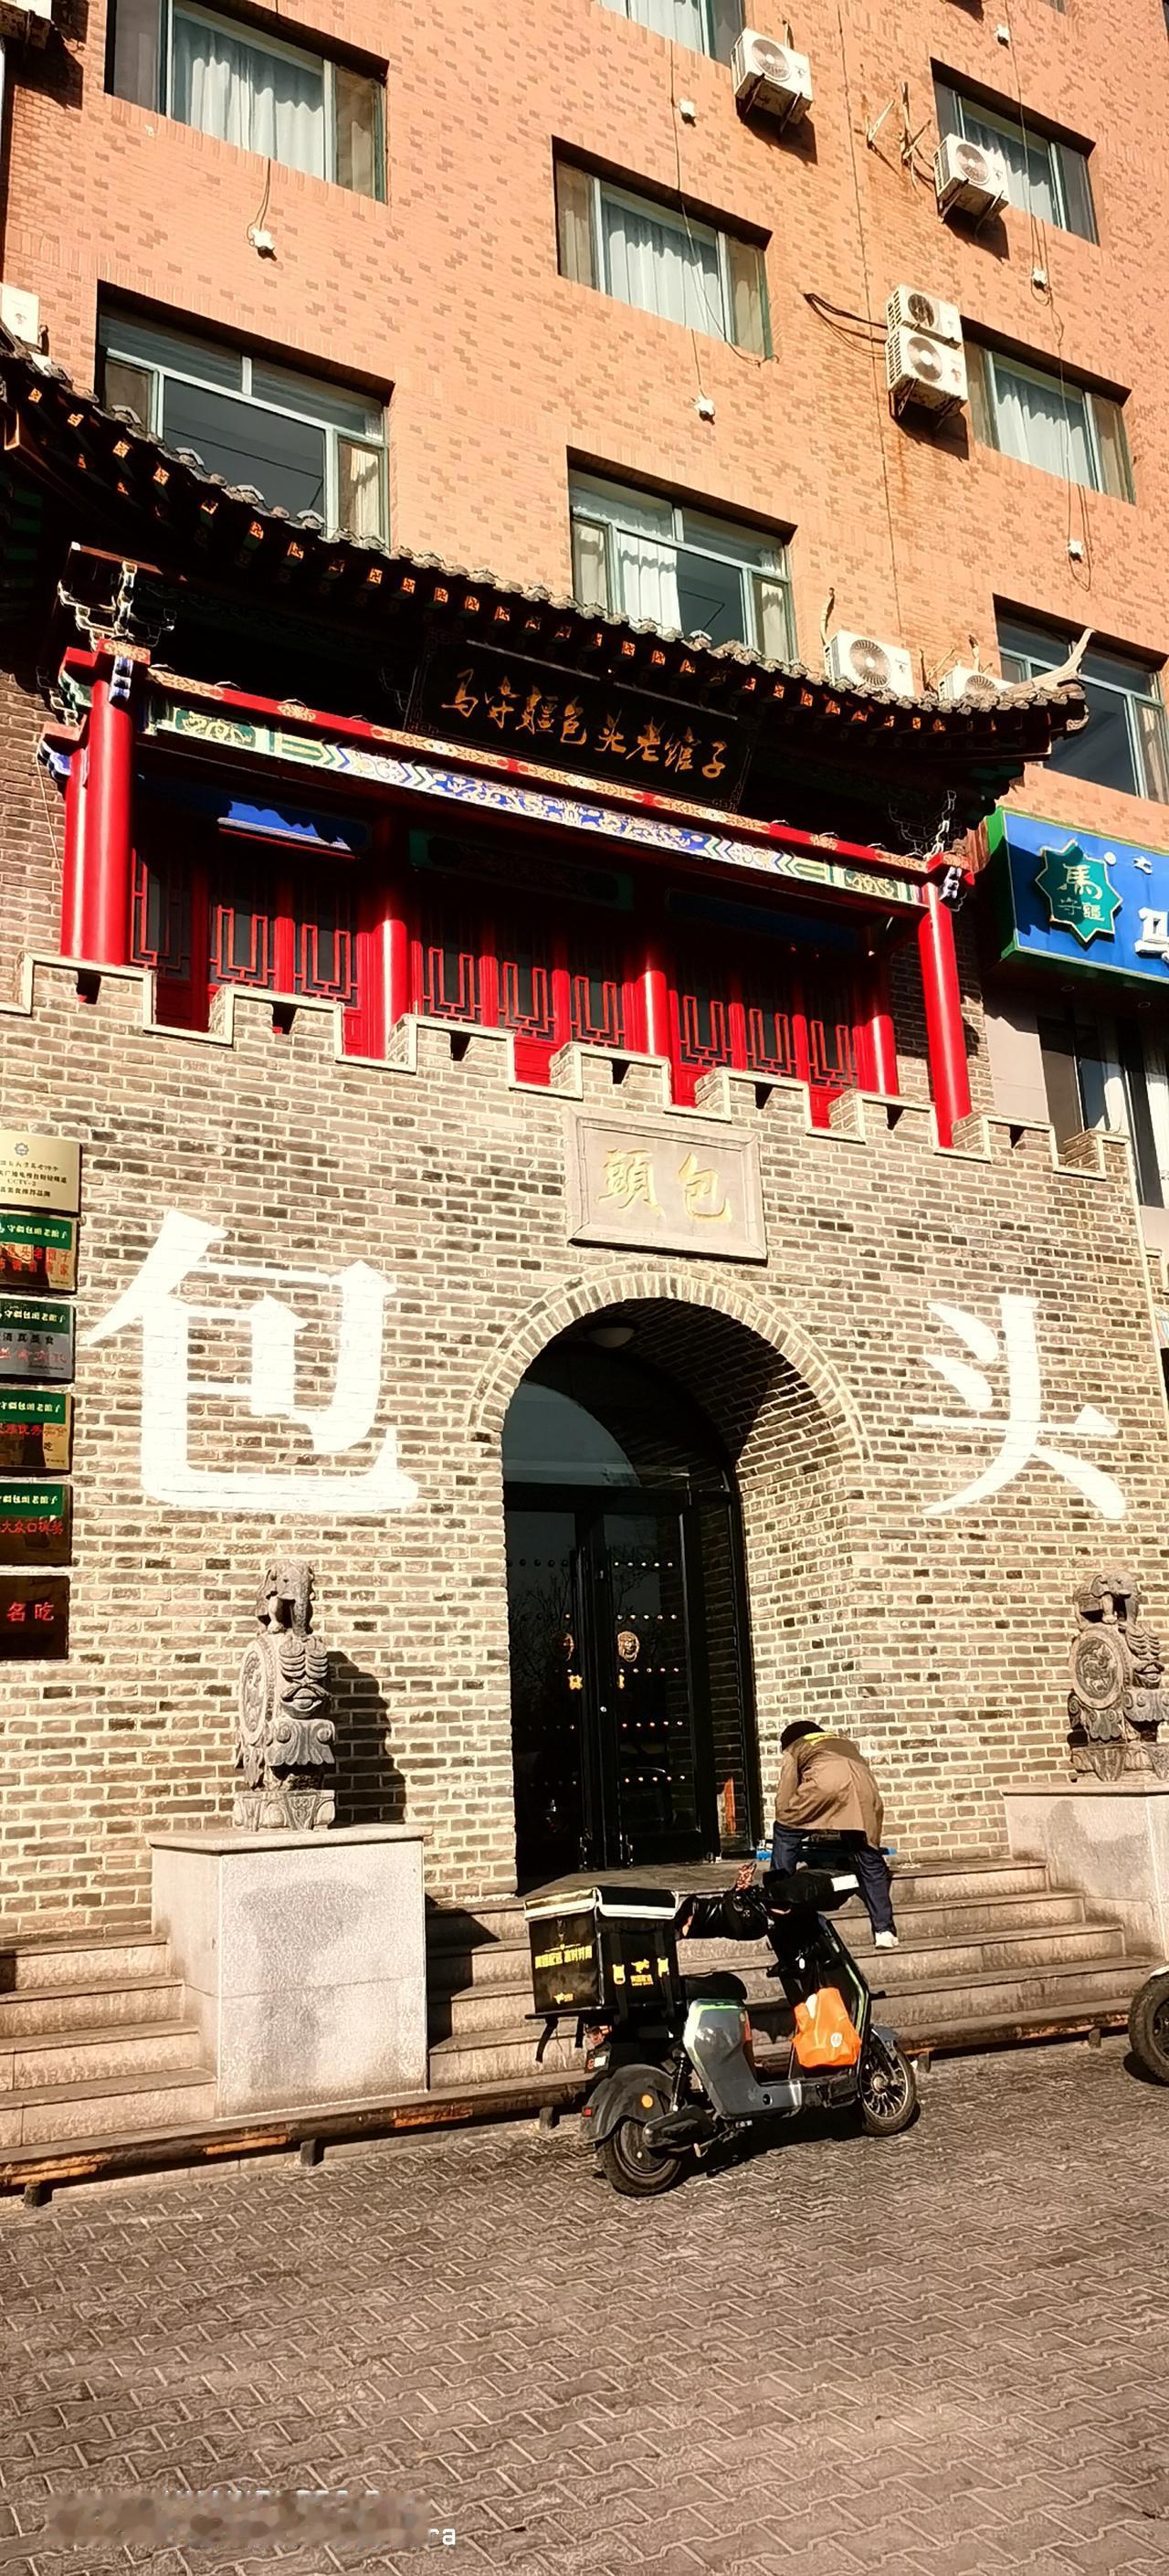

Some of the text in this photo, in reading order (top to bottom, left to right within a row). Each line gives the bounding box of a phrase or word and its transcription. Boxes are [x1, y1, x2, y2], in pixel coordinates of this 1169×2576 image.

[84, 1208, 1127, 1520] 包 头
[7, 1601, 55, 1621] 名吃
